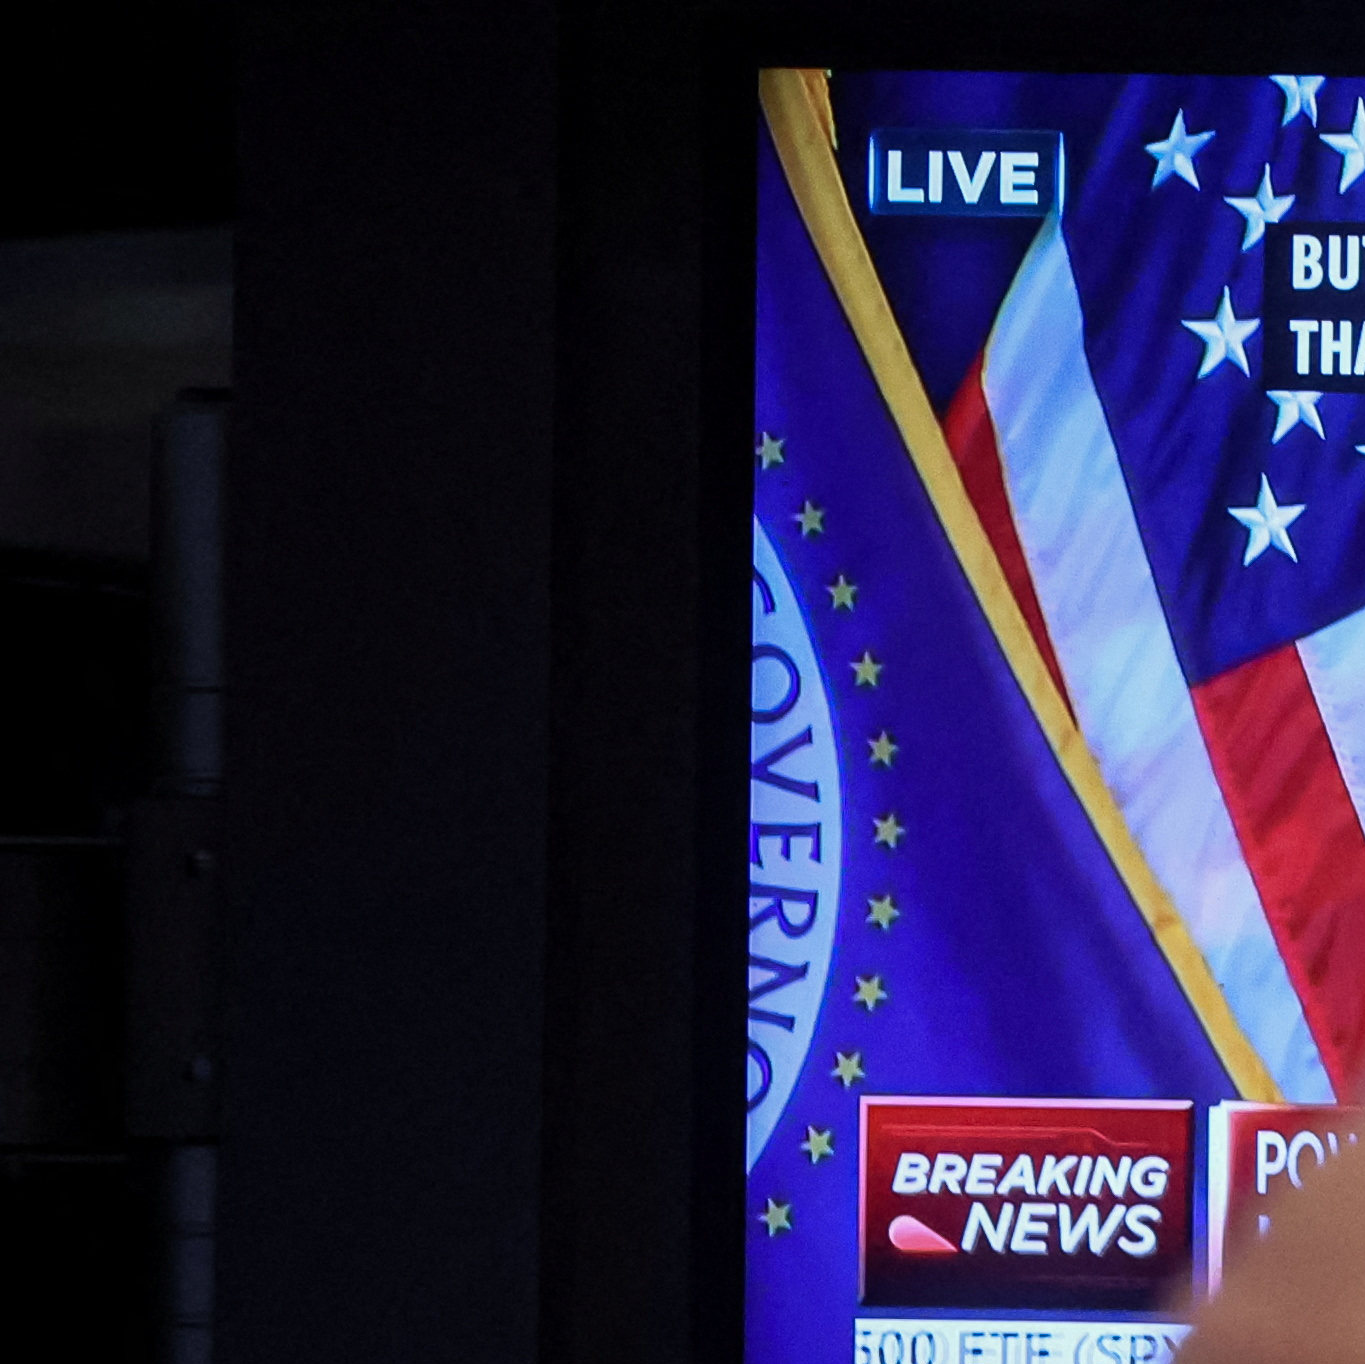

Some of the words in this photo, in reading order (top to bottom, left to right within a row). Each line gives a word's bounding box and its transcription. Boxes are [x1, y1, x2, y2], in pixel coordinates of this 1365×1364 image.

[887, 150, 1039, 205] LIVE
[892, 1153, 1170, 1199] BREAKING
[962, 1203, 1161, 1257] NEWS
